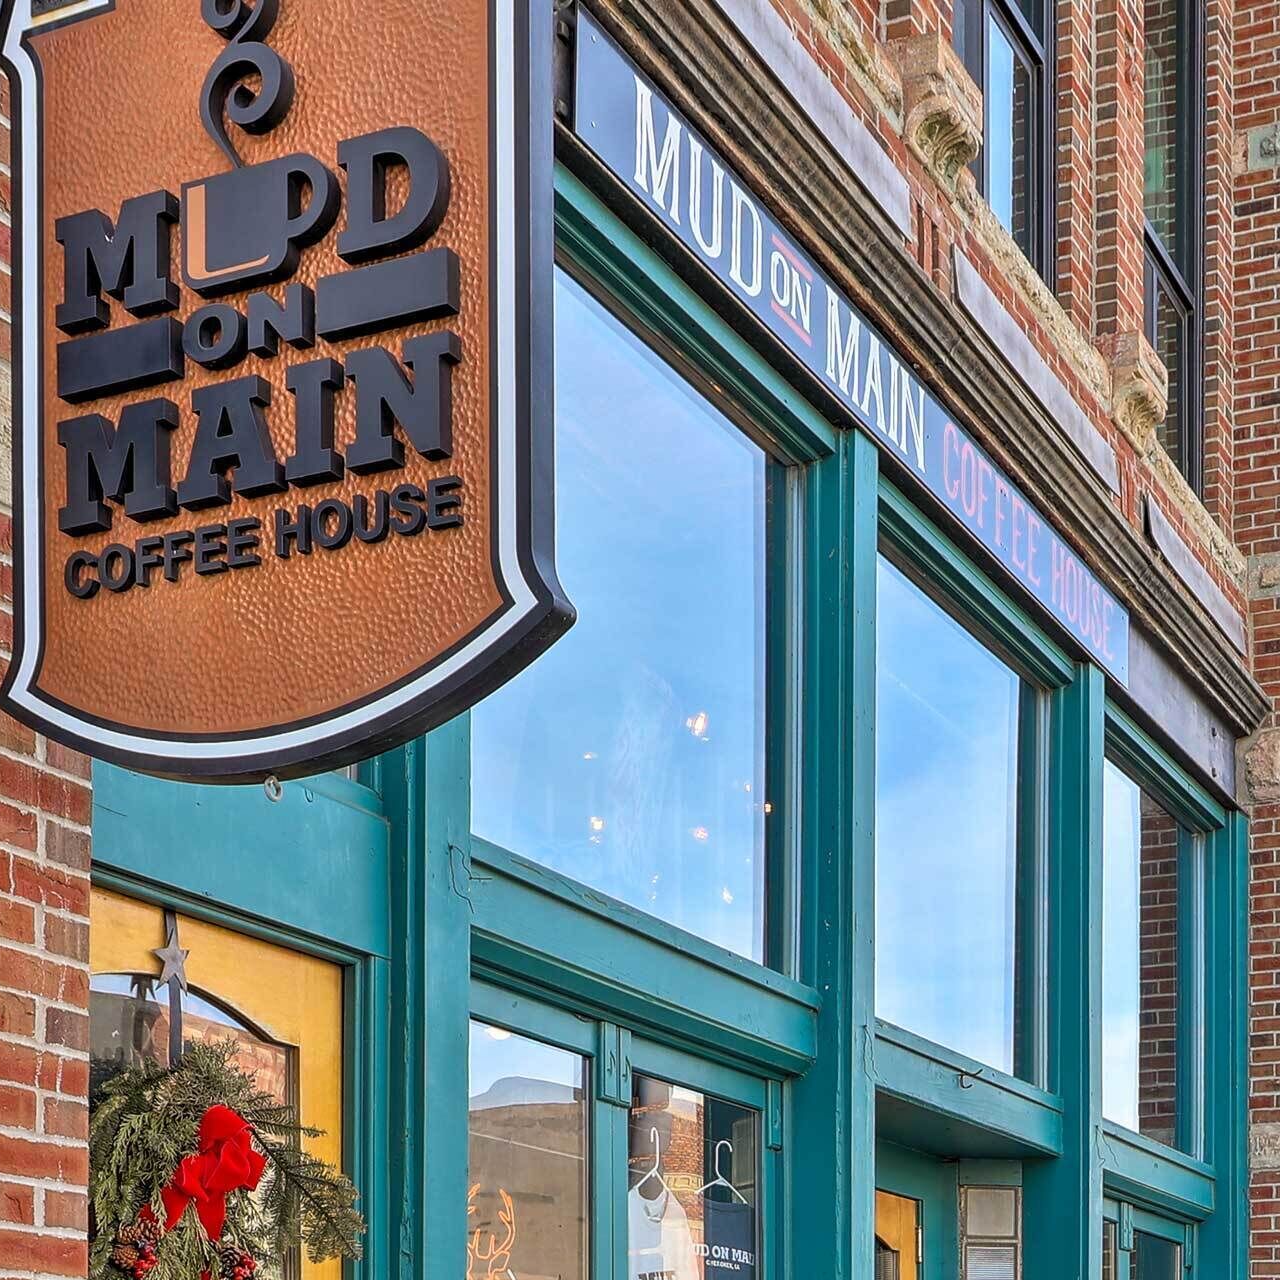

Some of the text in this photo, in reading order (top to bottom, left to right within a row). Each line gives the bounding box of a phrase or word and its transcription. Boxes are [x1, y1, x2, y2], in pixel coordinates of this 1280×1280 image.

[182, 282, 315, 370] ON
[632, 75, 1114, 661] MUD ON MAIN COFFEE HOUSE
[57, 331, 462, 537] MAIN
[64, 475, 465, 599] COFFEE HOUSE
